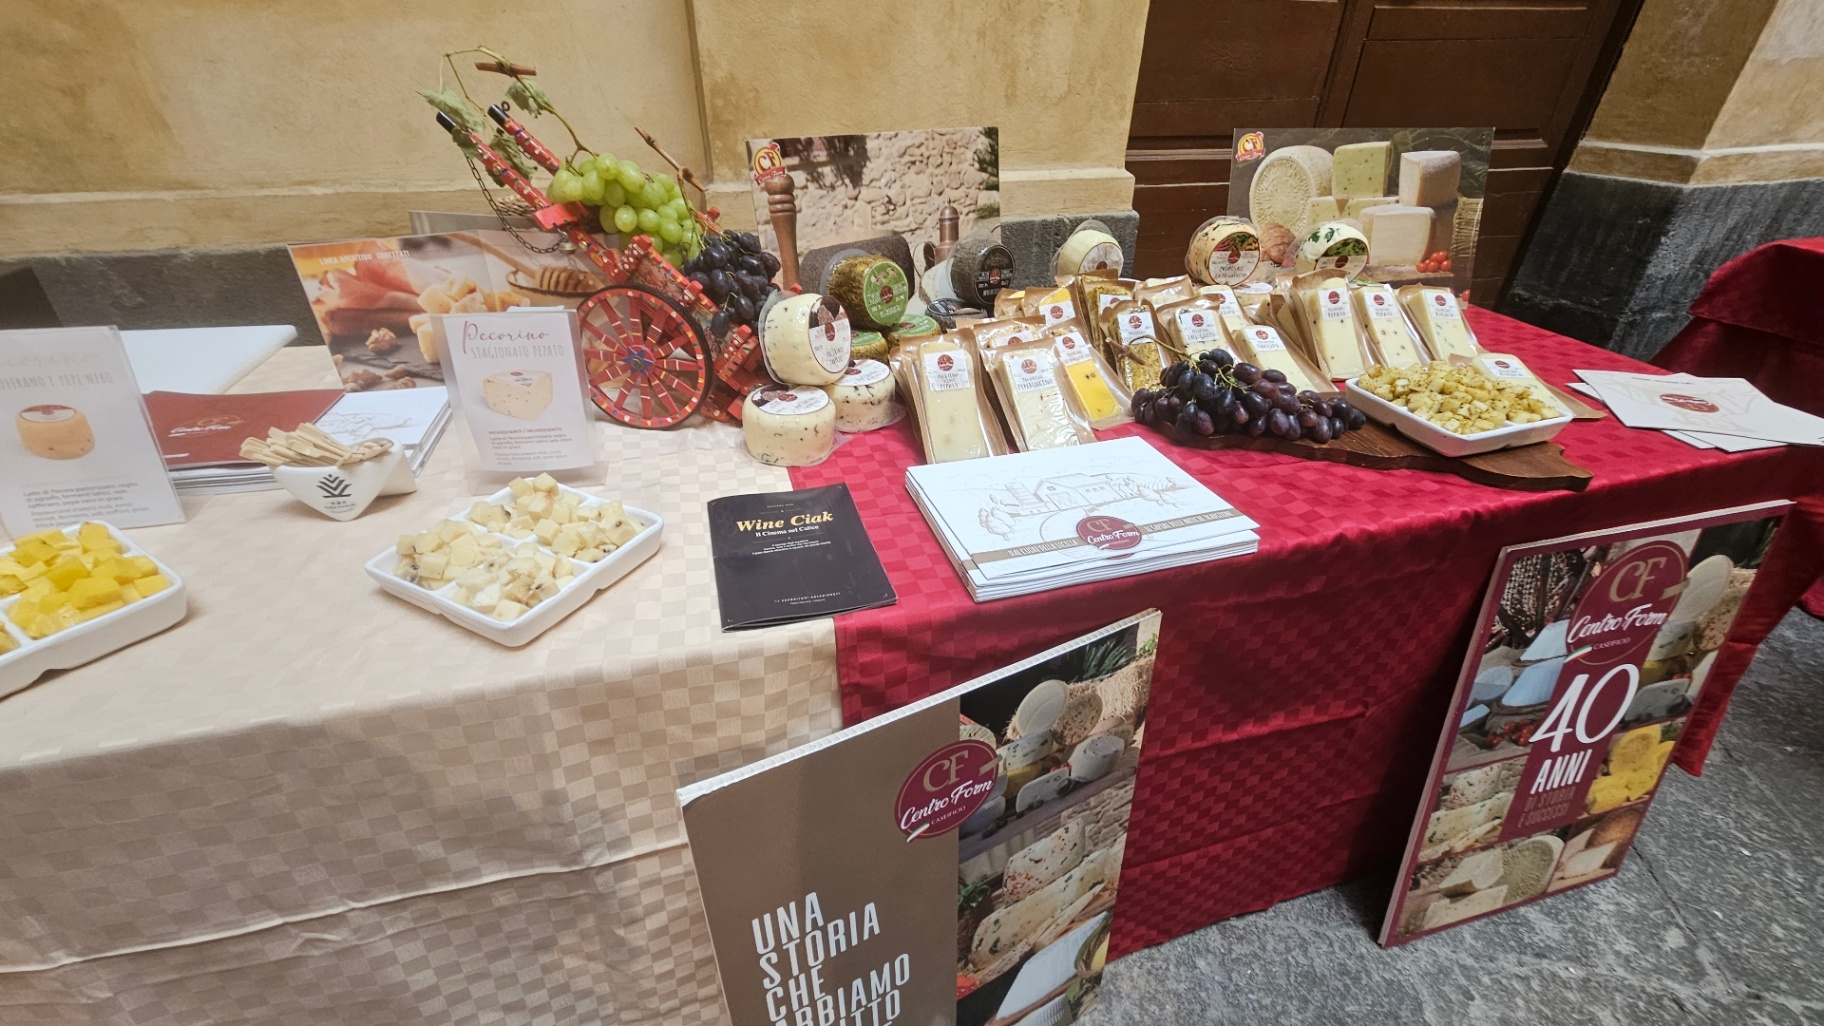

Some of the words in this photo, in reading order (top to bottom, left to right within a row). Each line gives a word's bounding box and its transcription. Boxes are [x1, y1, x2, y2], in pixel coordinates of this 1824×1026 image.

[319, 256, 339, 266] LINEA
[340, 252, 374, 263] APERITIVO
[462, 320, 550, 355] Pecorino
[470, 345, 530, 359] STAGIONATO
[533, 344, 564, 358] PEPATO
[85, 371, 115, 385] NERO
[1018, 379, 1054, 391] PEPERONCINO
[735, 518, 785, 533] Wine
[790, 511, 834, 527] Ciak
[762, 529, 787, 537] Cinema
[1086, 518, 1112, 532] CF
[1087, 533, 1114, 545] Centro
[1112, 530, 1140, 540] Form
[1020, 546, 1040, 555] CUORE
[1039, 543, 1056, 552] DELLA
[1055, 539, 1078, 549] SICILIA
[1609, 556, 1668, 603] CF
[1567, 612, 1623, 643] Centro
[1622, 603, 1667, 631] Form
[1528, 663, 1639, 752] 40
[923, 750, 969, 792] CF
[1529, 749, 1593, 795] ANNI
[900, 797, 949, 830] Centro
[950, 780, 994, 805] Form
[931, 805, 966, 825] CASEIFICIO
[751, 891, 825, 955] UNA
[758, 902, 881, 990] STORIA
[766, 965, 826, 1022] CHE
[775, 953, 910, 1026] BBIAMO
[839, 989, 900, 1026] TTO
